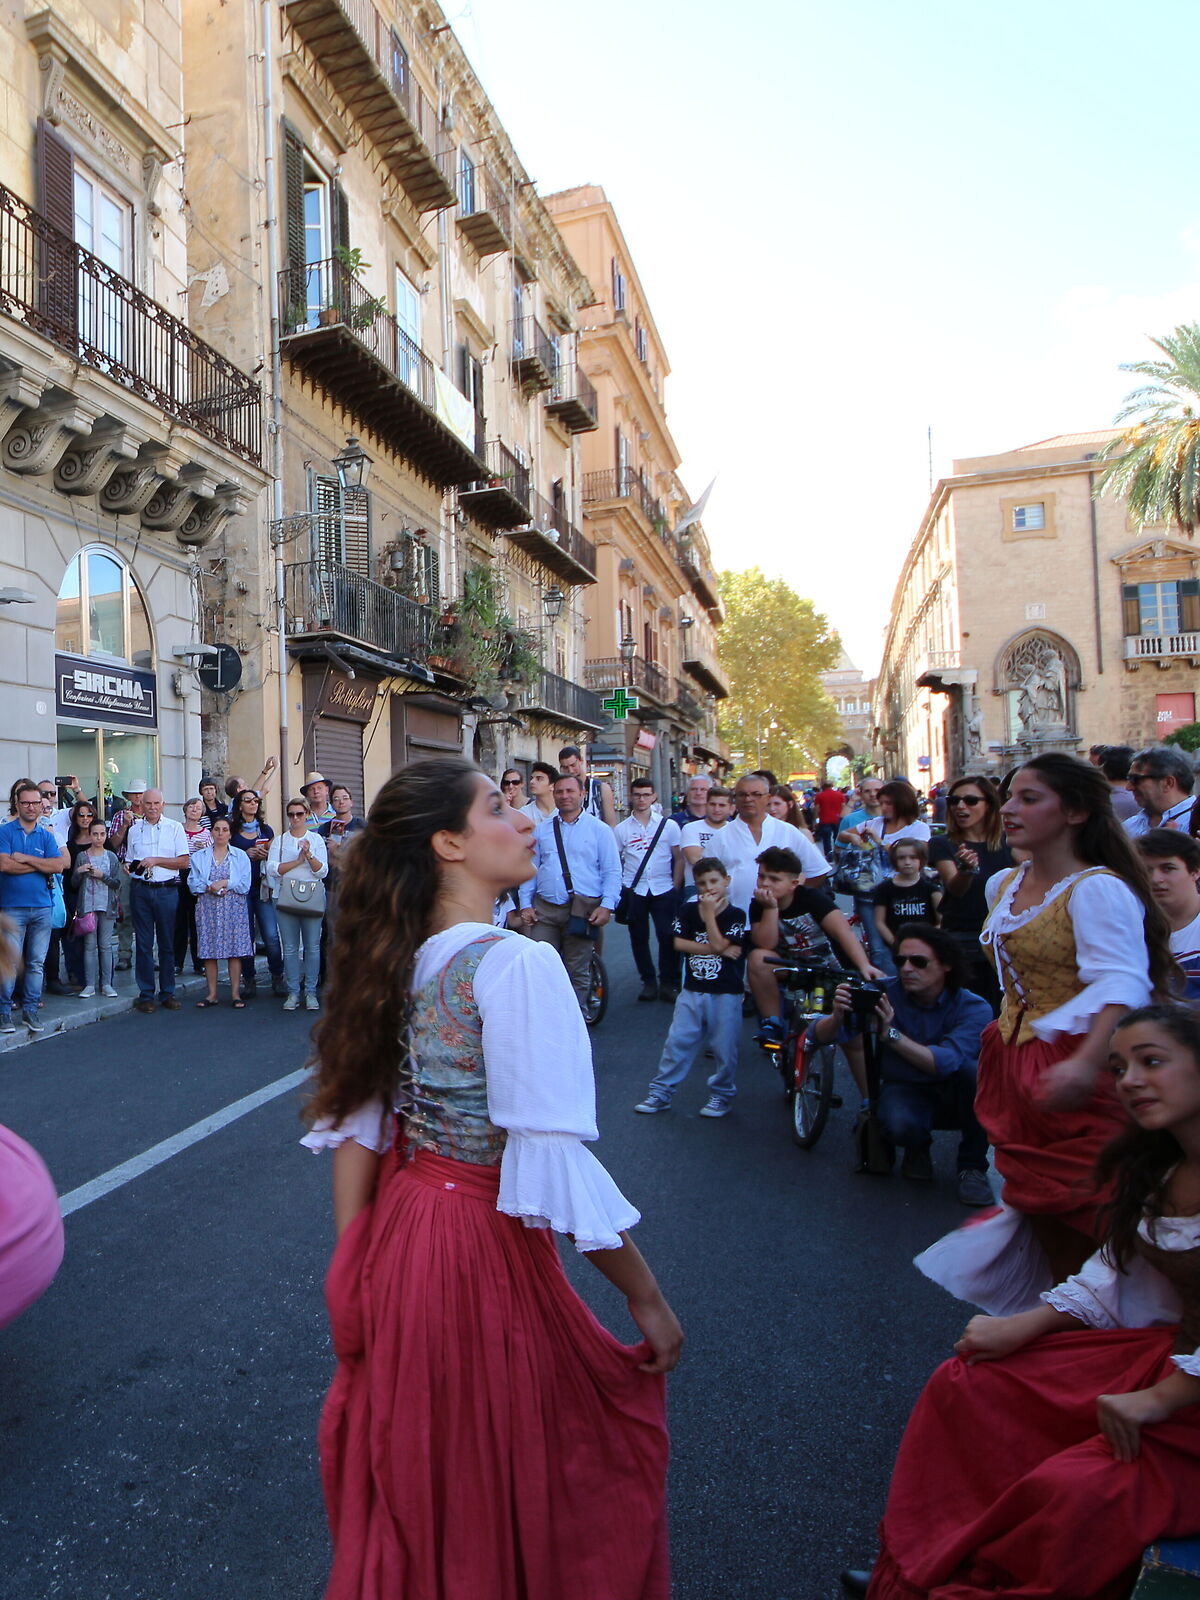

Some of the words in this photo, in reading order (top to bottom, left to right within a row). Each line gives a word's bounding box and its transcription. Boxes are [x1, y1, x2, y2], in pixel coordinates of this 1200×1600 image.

[73, 669, 145, 701] SIRCHIA
[65, 689, 94, 703] Confezioni
[95, 694, 133, 709] Abbigliamento
[134, 700, 150, 711] Uomo
[894, 902, 927, 916] SHINE
